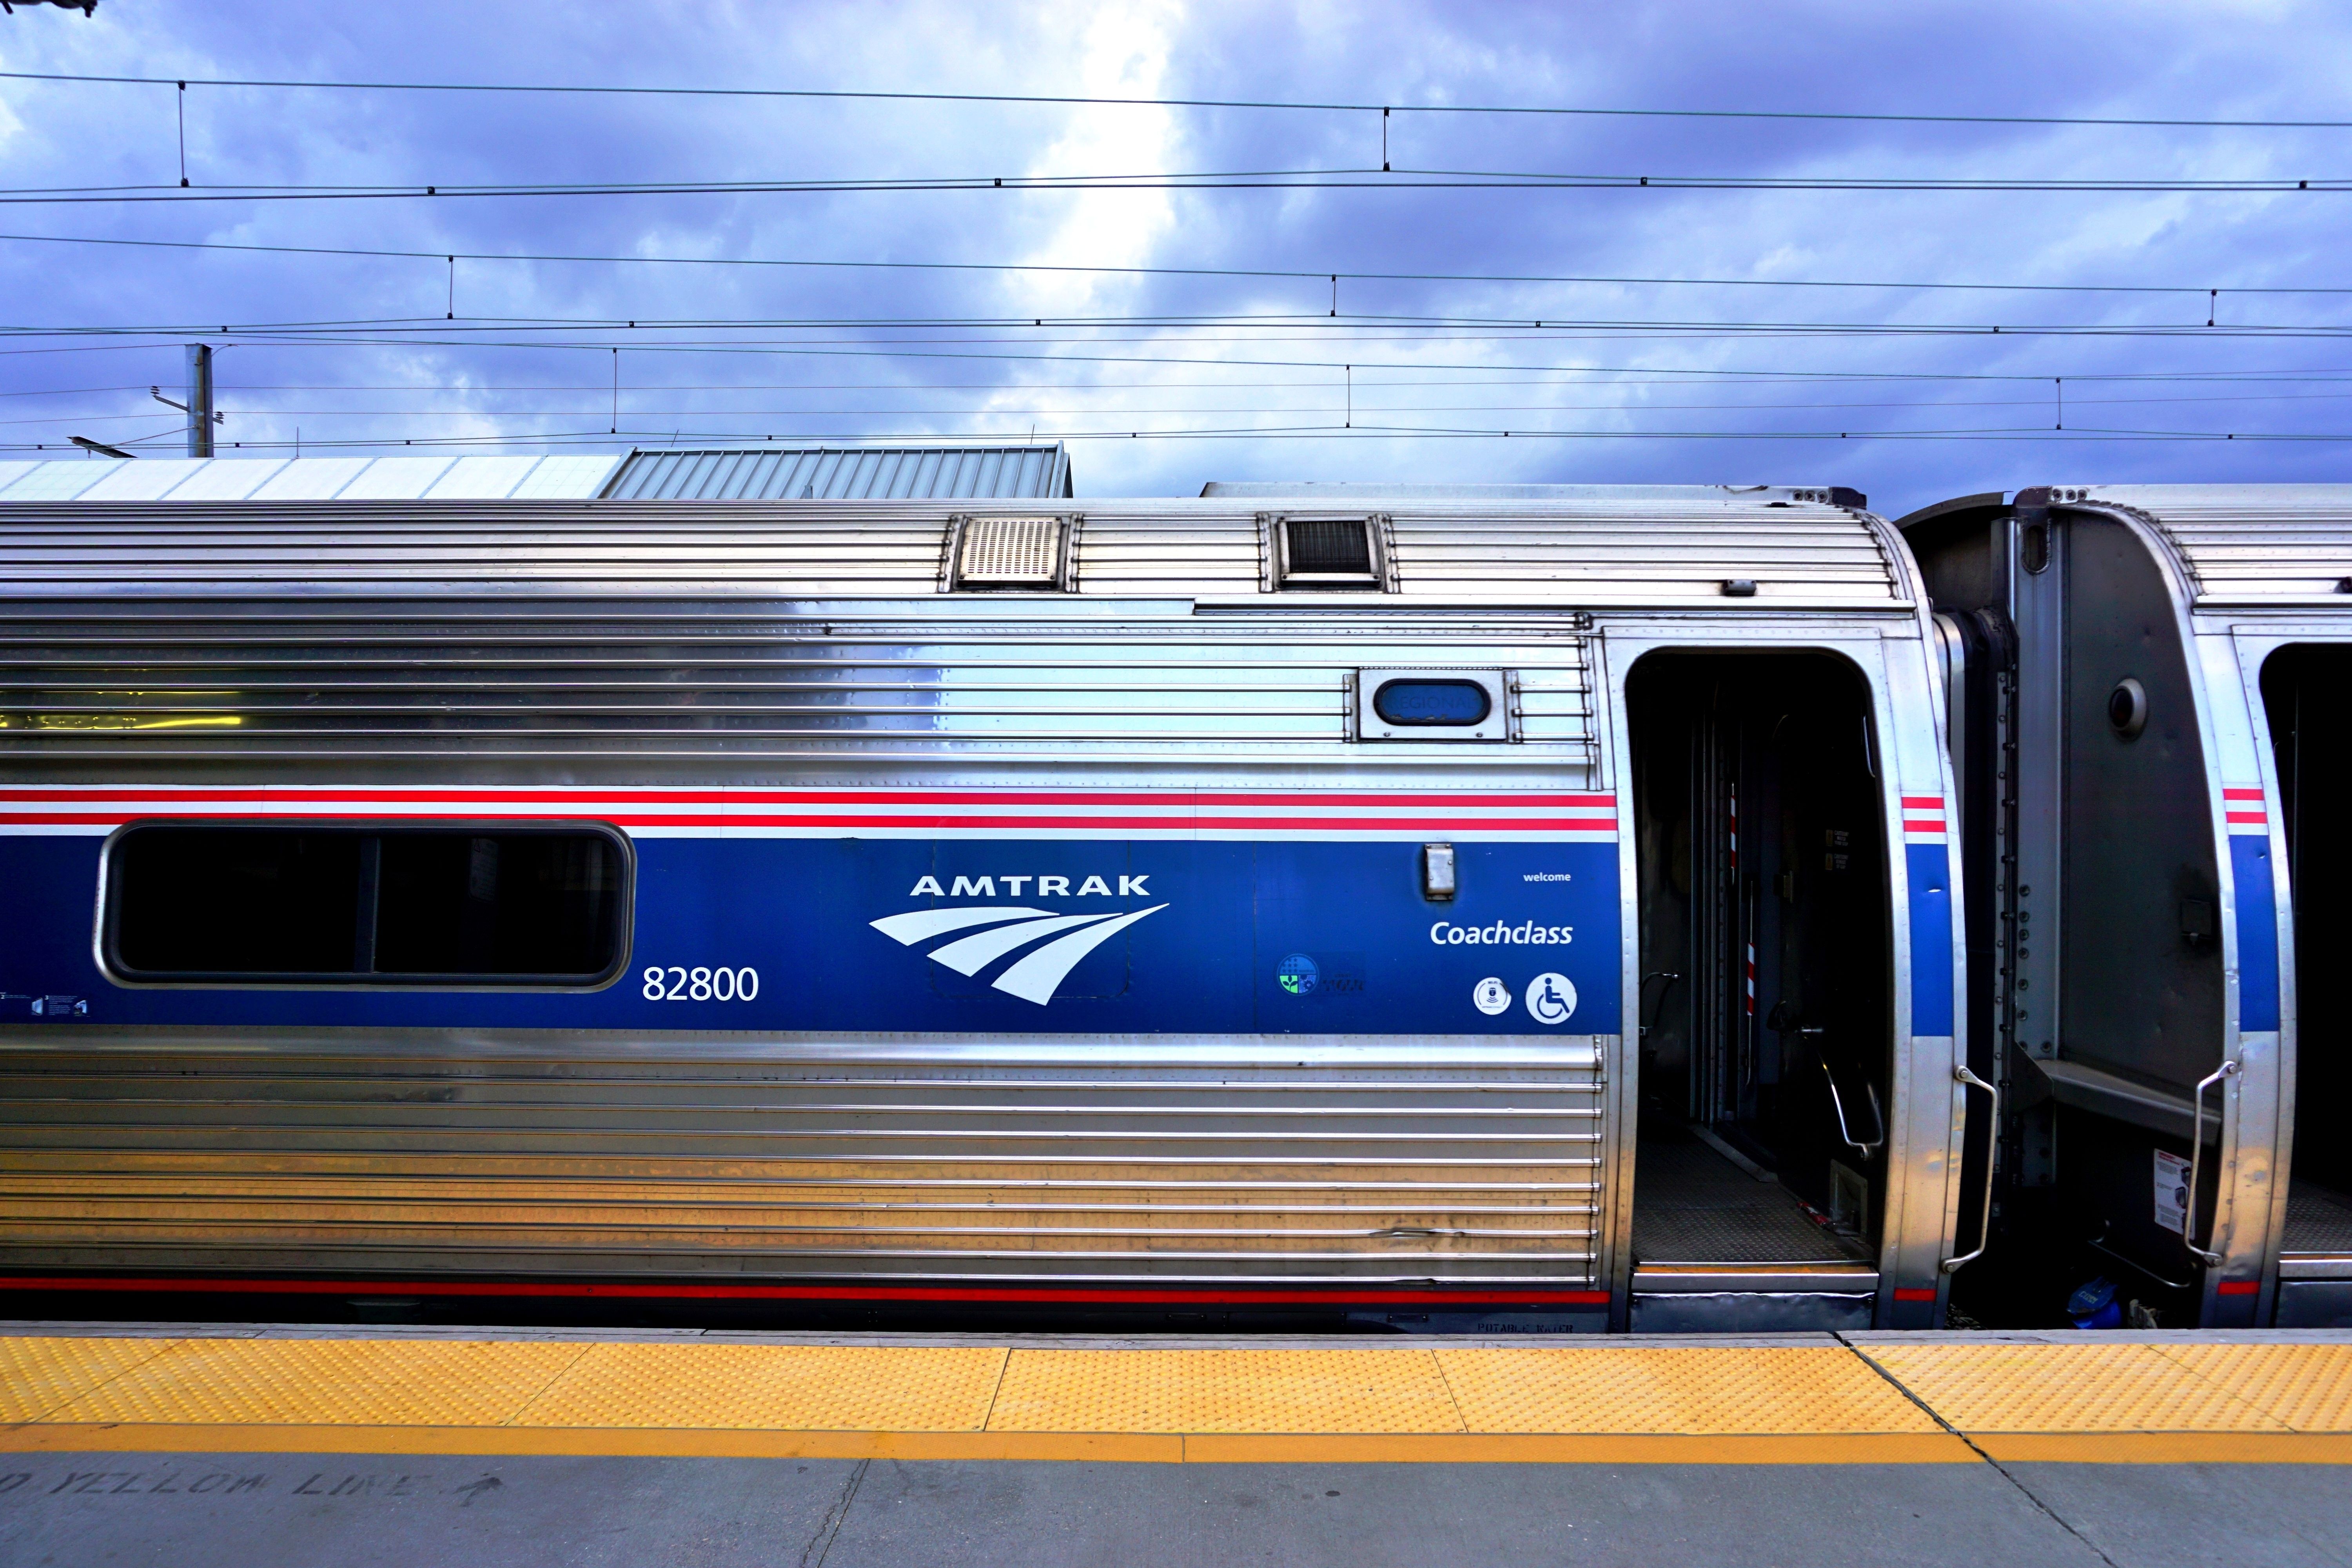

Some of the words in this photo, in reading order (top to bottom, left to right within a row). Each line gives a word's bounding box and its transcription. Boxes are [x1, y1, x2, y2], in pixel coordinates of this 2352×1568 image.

[1393, 696, 1475, 709] EGIONAL
[909, 875, 1151, 896] AMTRAK
[1523, 872, 1571, 882] welcome
[1430, 920, 1573, 944] Coachclass
[642, 966, 759, 1001] 82800
[1478, 1323, 1528, 1332] POTABLE
[49, 1472, 273, 1494] YELLOW
